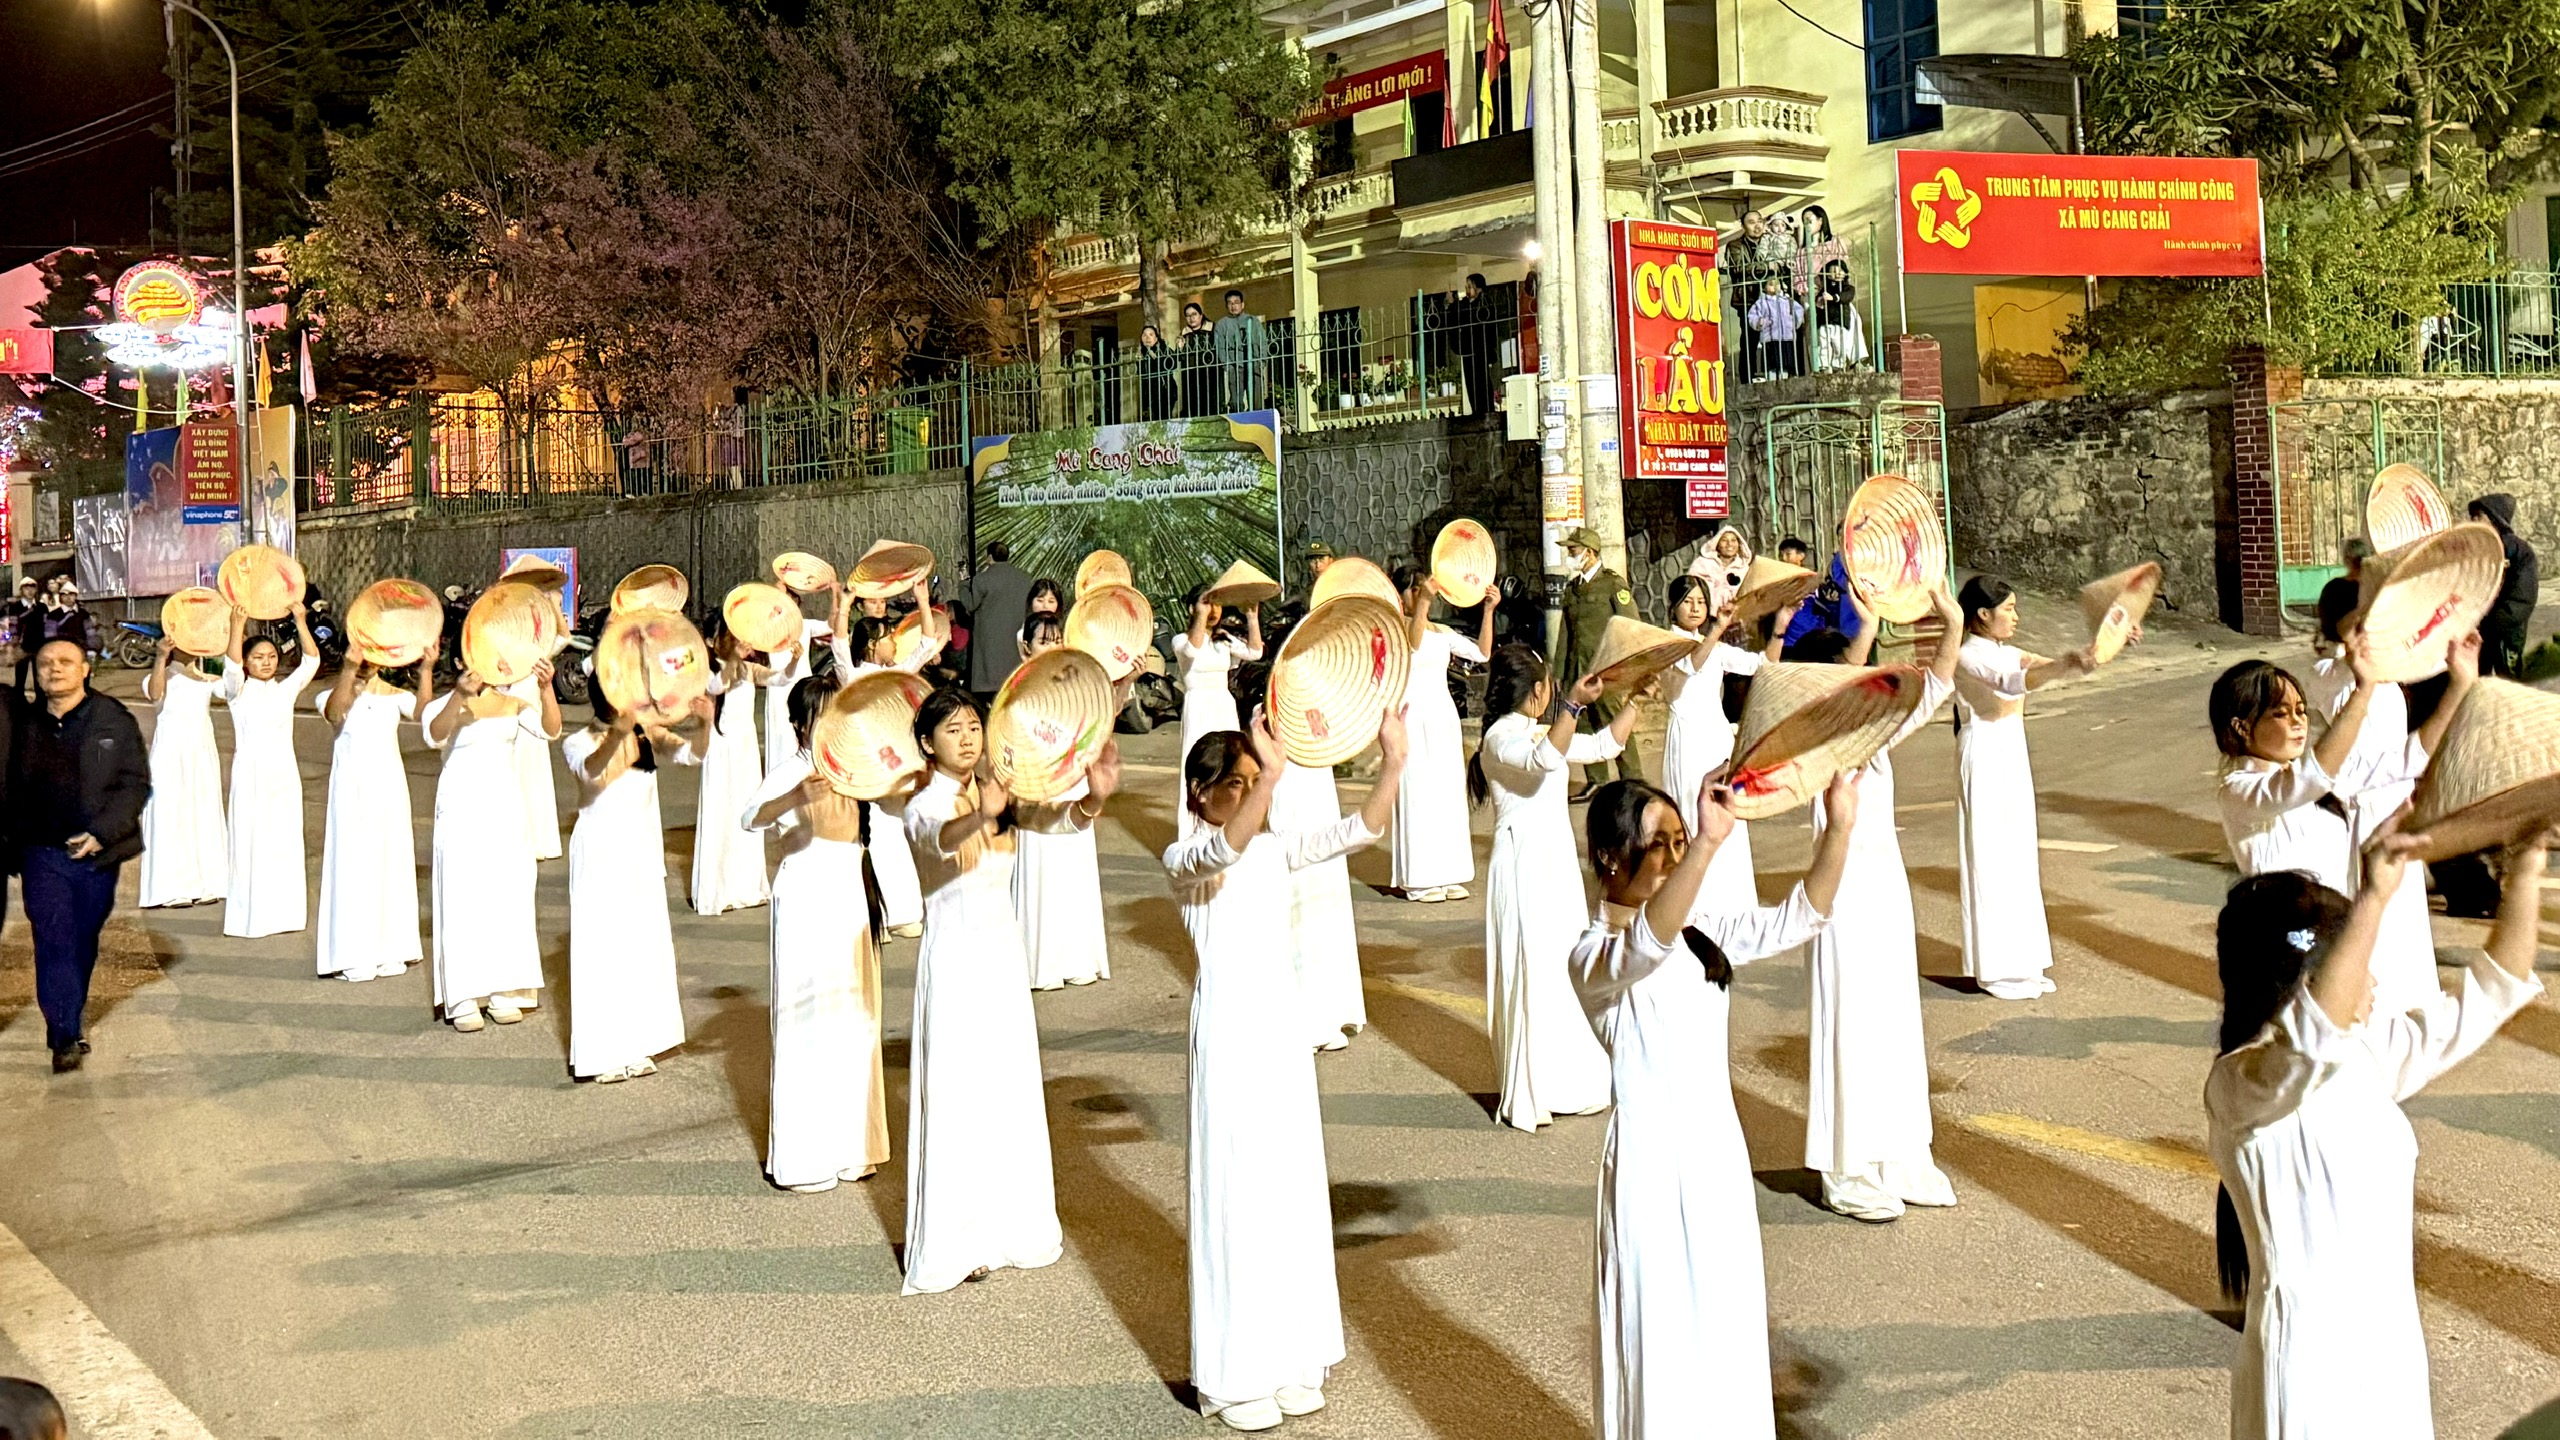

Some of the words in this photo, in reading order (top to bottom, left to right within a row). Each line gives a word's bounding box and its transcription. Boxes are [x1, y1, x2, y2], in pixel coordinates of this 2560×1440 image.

[1375, 76, 1395, 98] LỢI
[1398, 64, 1424, 90] MỚI
[1986, 177, 2031, 197] TRUNG
[2033, 174, 2062, 198] TÂM
[2064, 178, 2100, 202] PHỤC
[2101, 179, 2119, 202] VỤ
[2121, 176, 2157, 199] HÀNH
[2158, 177, 2198, 200] CHÍNH
[2200, 178, 2235, 201] CÔNG
[2059, 205, 2078, 229] XÃ
[2079, 205, 2100, 229] MÙ
[2102, 209, 2138, 229] CANG
[2140, 202, 2171, 230] CHẢI
[1639, 228, 1656, 244] NHÀ
[1657, 229, 1680, 247] HÀNG
[1681, 230, 1700, 249] SUỐI
[1701, 235, 1715, 250] MƠ
[2164, 239, 2186, 249] Hành
[2211, 240, 2231, 252] phục
[2232, 242, 2243, 252] vụ
[1633, 252, 1722, 324] CƠM
[1636, 326, 1726, 415] LẨU
[191, 429, 206, 437] XÂY
[193, 439, 207, 447] GIA
[1702, 421, 1727, 446] TIỆC
[192, 449, 208, 459] VIỆT
[210, 450, 229, 458] NAM
[1088, 446, 1132, 475] Cang
[185, 510, 223, 521] vinaphone
